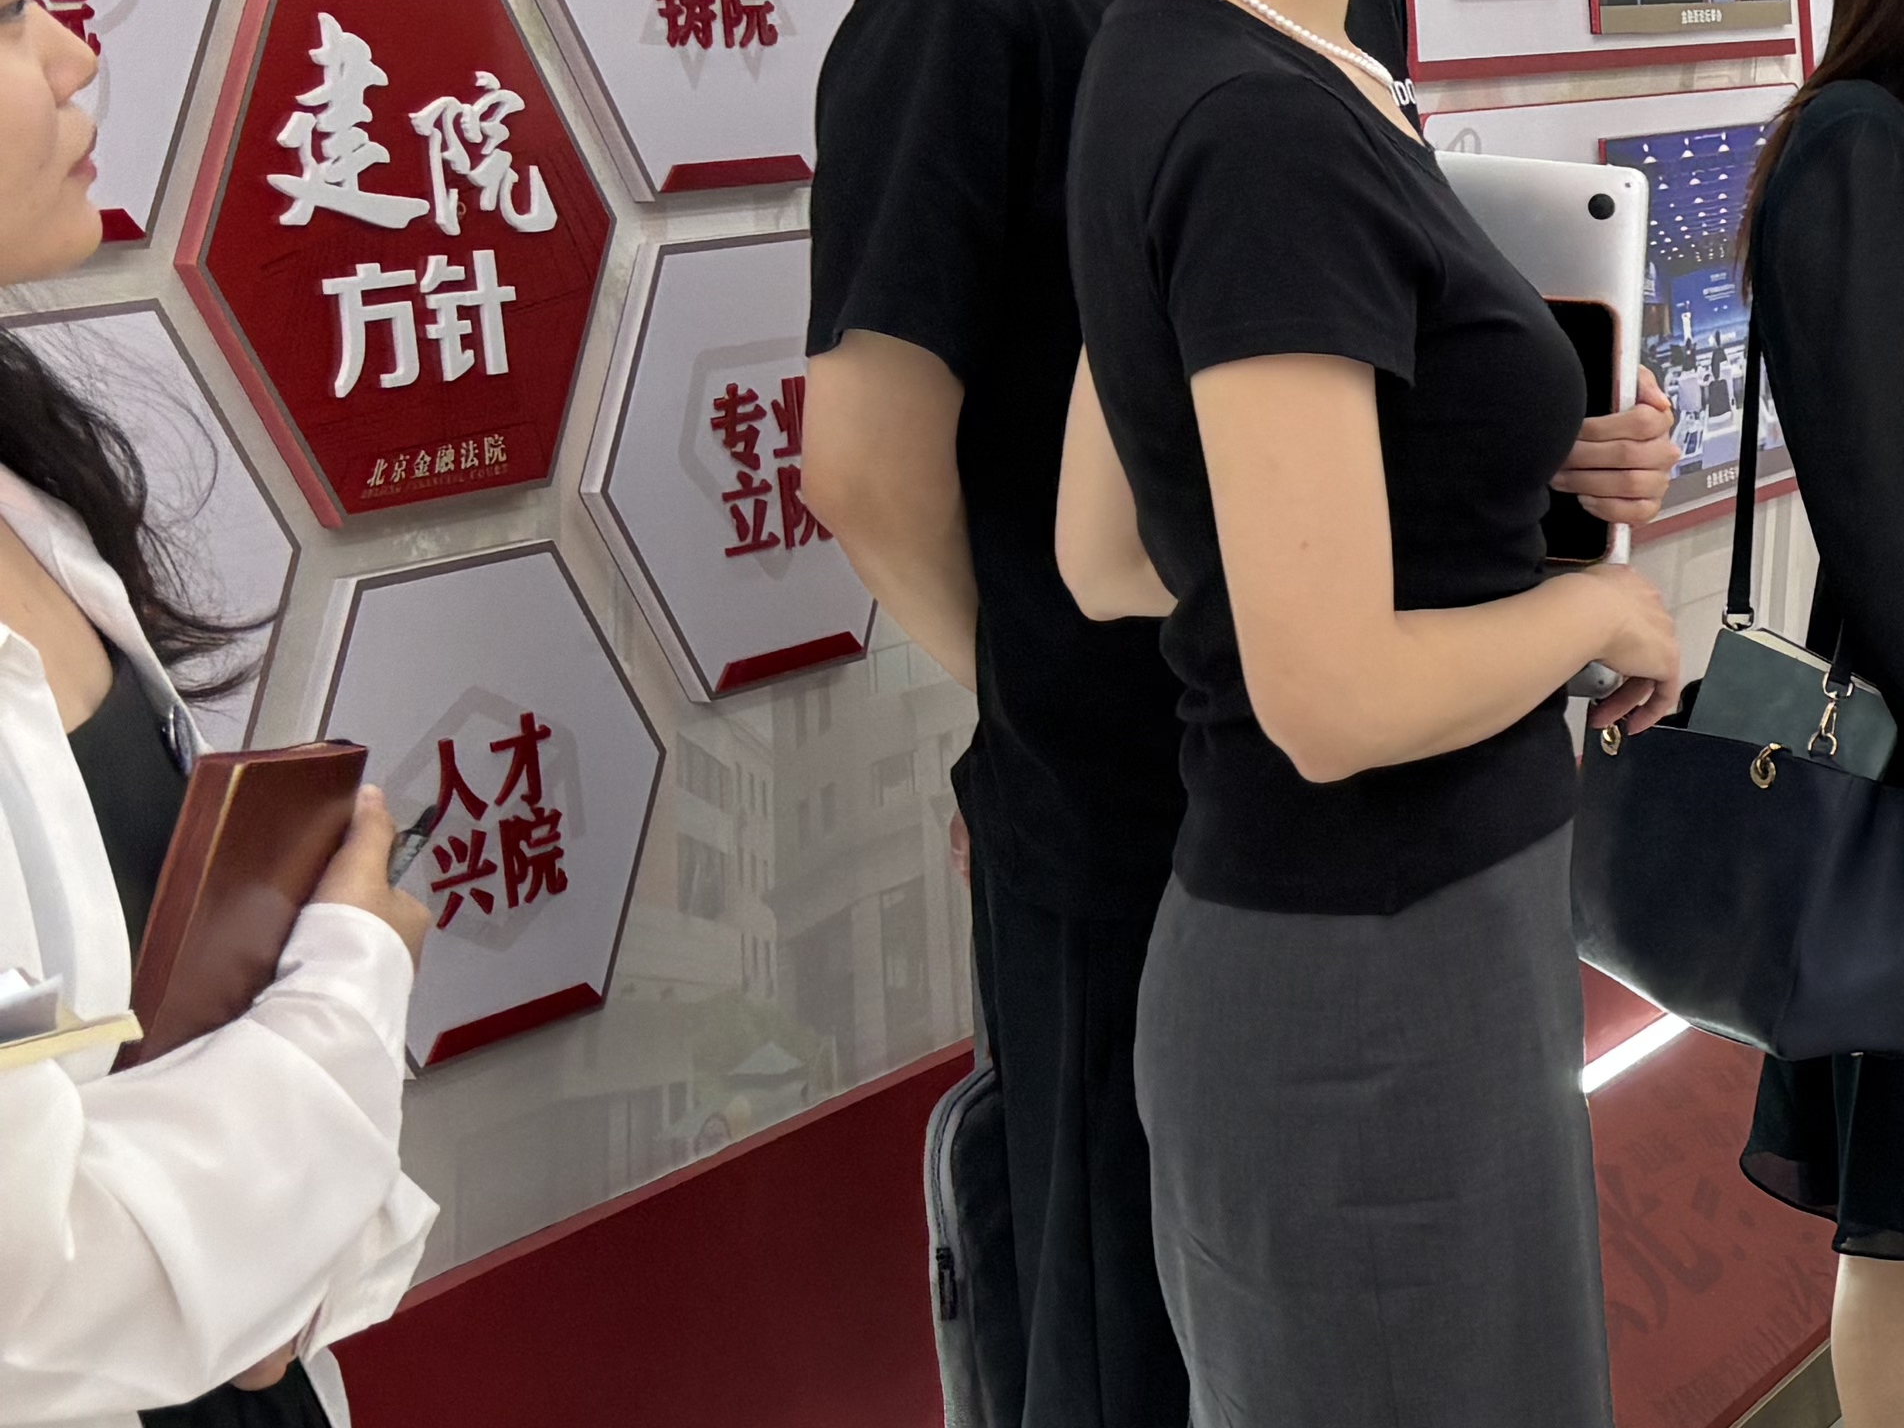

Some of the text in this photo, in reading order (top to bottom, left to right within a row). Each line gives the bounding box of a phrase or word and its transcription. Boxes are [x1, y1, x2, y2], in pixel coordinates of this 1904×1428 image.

[267, 12, 559, 235] 建院
[321, 249, 517, 398] 方针
[366, 433, 508, 488] 北京金融法院
[435, 712, 551, 823] 人才
[430, 803, 569, 930] 兴院
